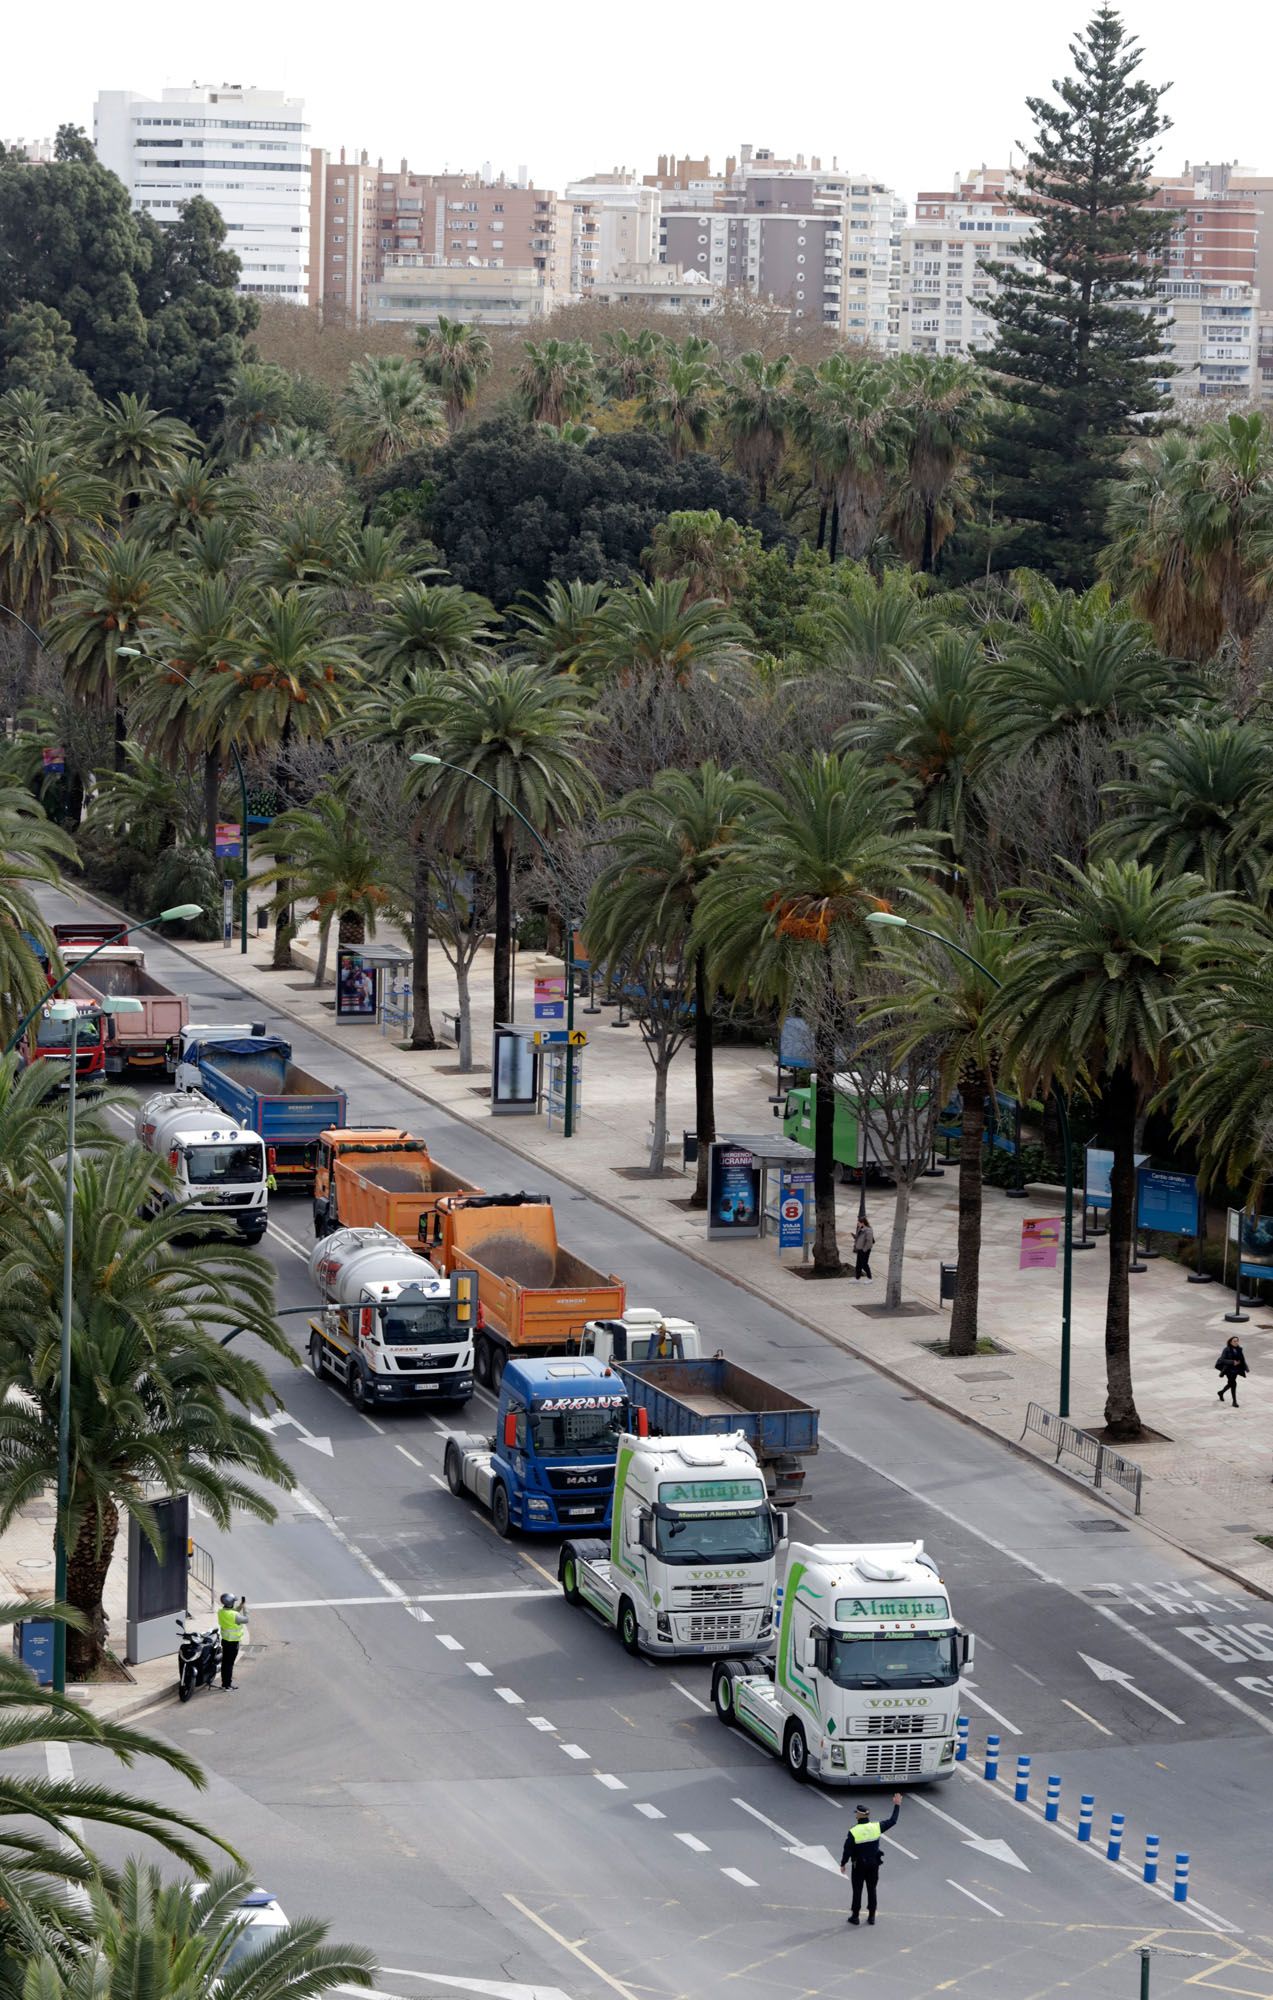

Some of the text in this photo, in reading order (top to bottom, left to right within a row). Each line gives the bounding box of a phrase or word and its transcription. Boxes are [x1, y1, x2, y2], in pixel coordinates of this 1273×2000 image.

[541, 1032, 551, 1044] P
[785, 1206, 799, 1219] 8
[540, 1396, 624, 1411] ARRANZ
[566, 1476, 598, 1484] MAN
[672, 1484, 753, 1500] Almapa
[691, 1570, 746, 1579] VOLVO
[850, 1600, 936, 1618] Almapa
[884, 1631, 915, 1639] Alonso
[927, 1630, 948, 1638] Vera
[869, 1698, 929, 1707] VOLVO
